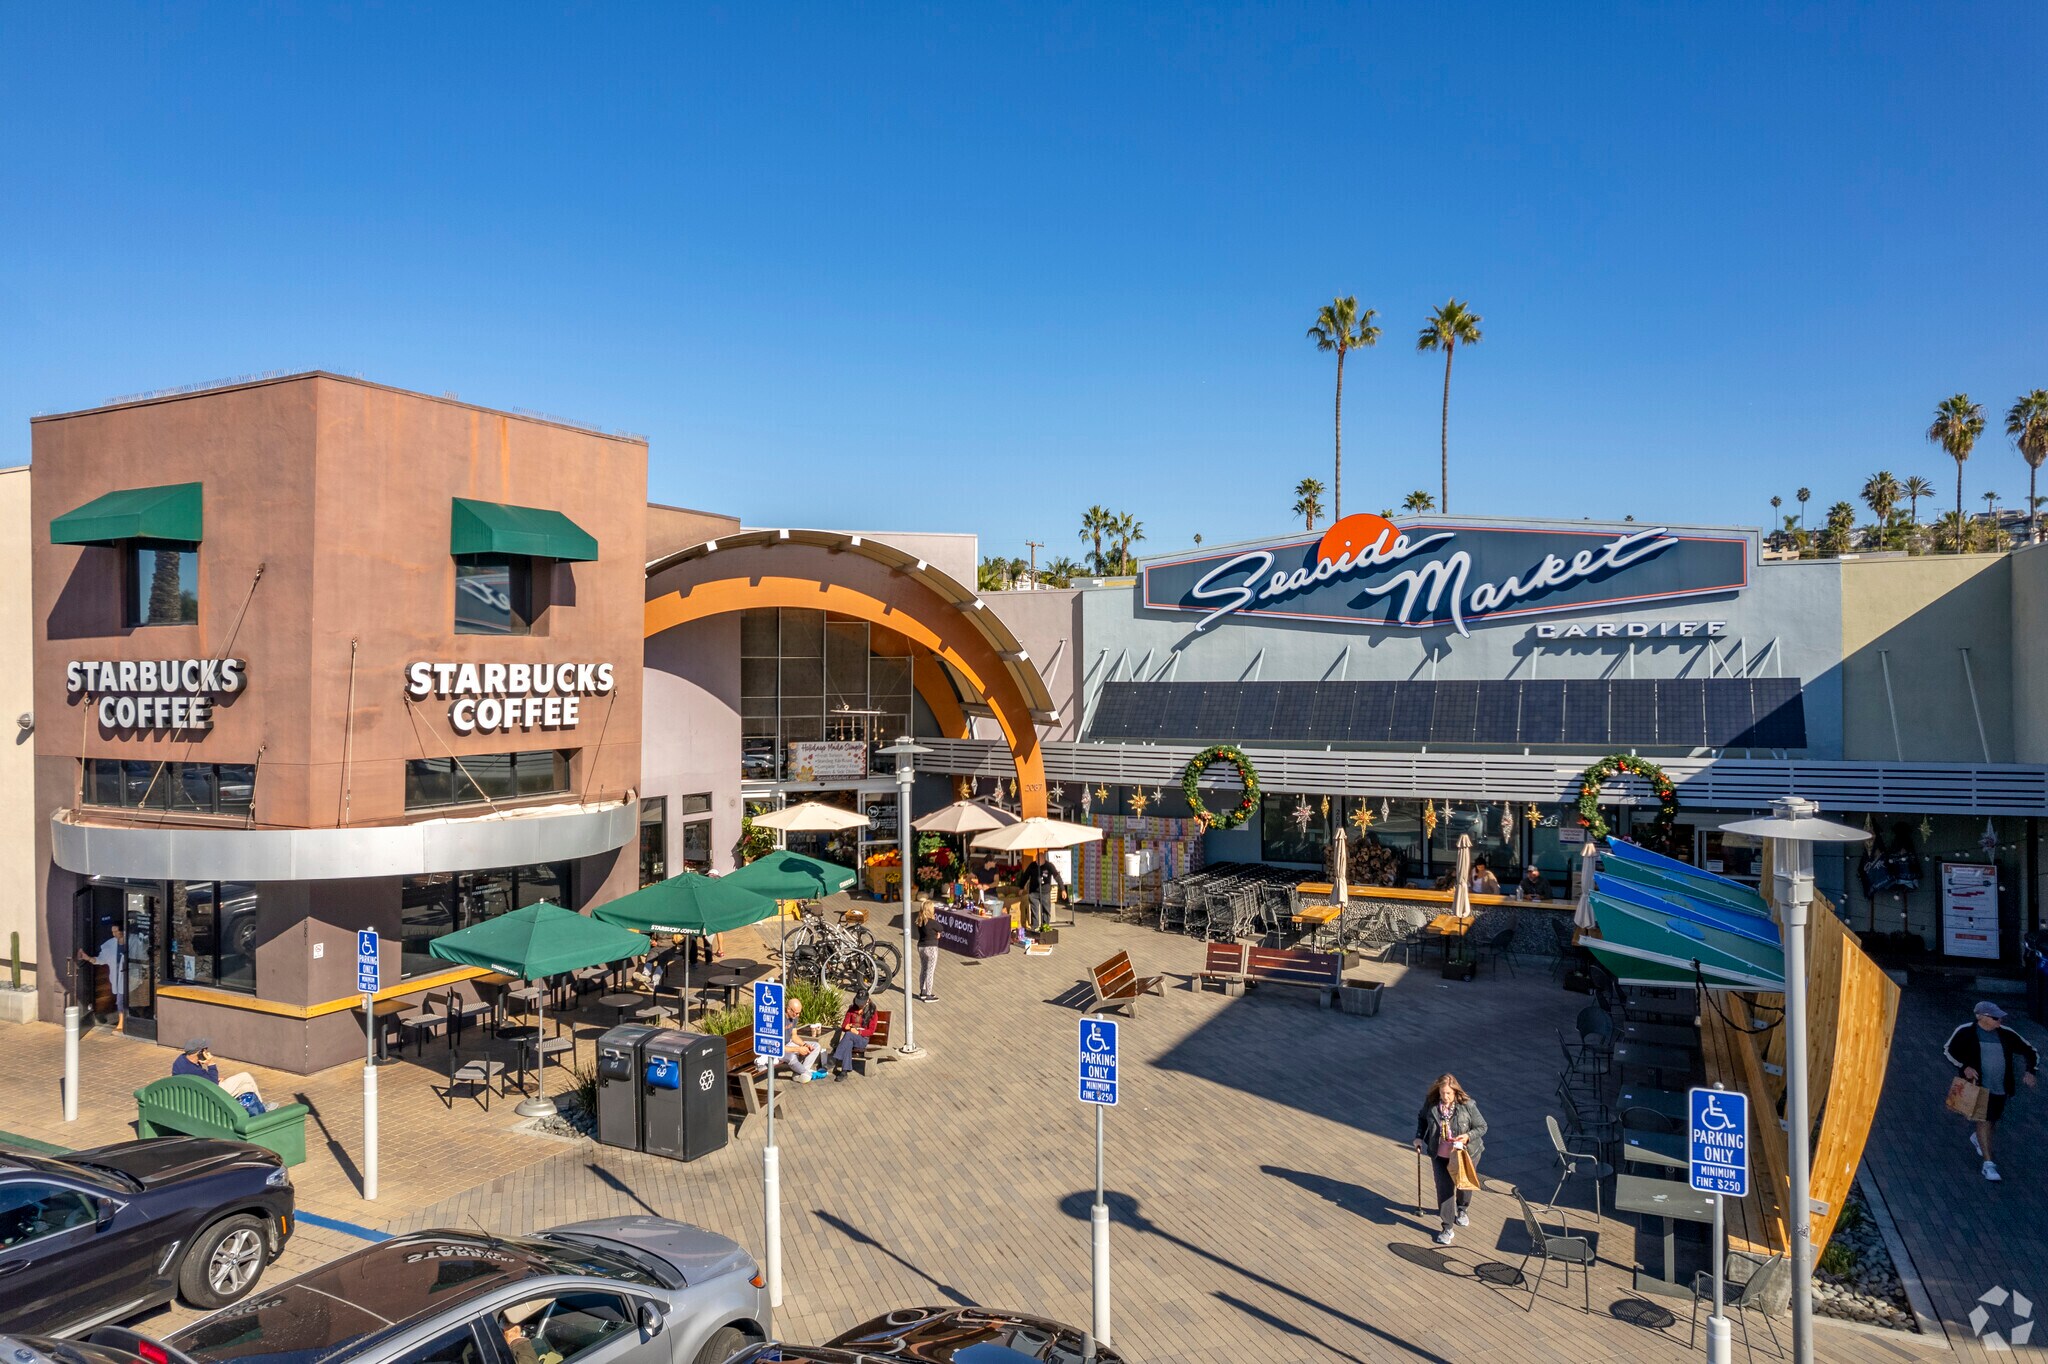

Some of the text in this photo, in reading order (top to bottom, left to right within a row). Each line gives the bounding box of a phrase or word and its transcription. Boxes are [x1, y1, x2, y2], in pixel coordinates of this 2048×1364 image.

[1192, 528, 1456, 631] Seaside
[1365, 527, 1679, 638] Market
[1537, 622, 1726, 638] CARDIFF
[67, 659, 240, 692] STARBUCKS
[410, 662, 614, 694] STARBUCKS
[99, 696, 205, 728] COFFEE
[453, 697, 579, 731] COFFEE
[934, 913, 973, 933] OCAL ROOTS
[759, 1005, 779, 1015] PARKING
[763, 1014, 775, 1023] ONLY
[1081, 1052, 1115, 1067] PARKING
[1088, 1065, 1109, 1079] ONLY
[1082, 1090, 1095, 1100] FINE
[1086, 1081, 1110, 1092] MINIMUM
[1693, 1129, 1743, 1149] PARKING
[1704, 1146, 1734, 1164] ONLY
[1701, 1165, 1736, 1179] MINIMUM
[1696, 1176, 1740, 1192] FINE $250
